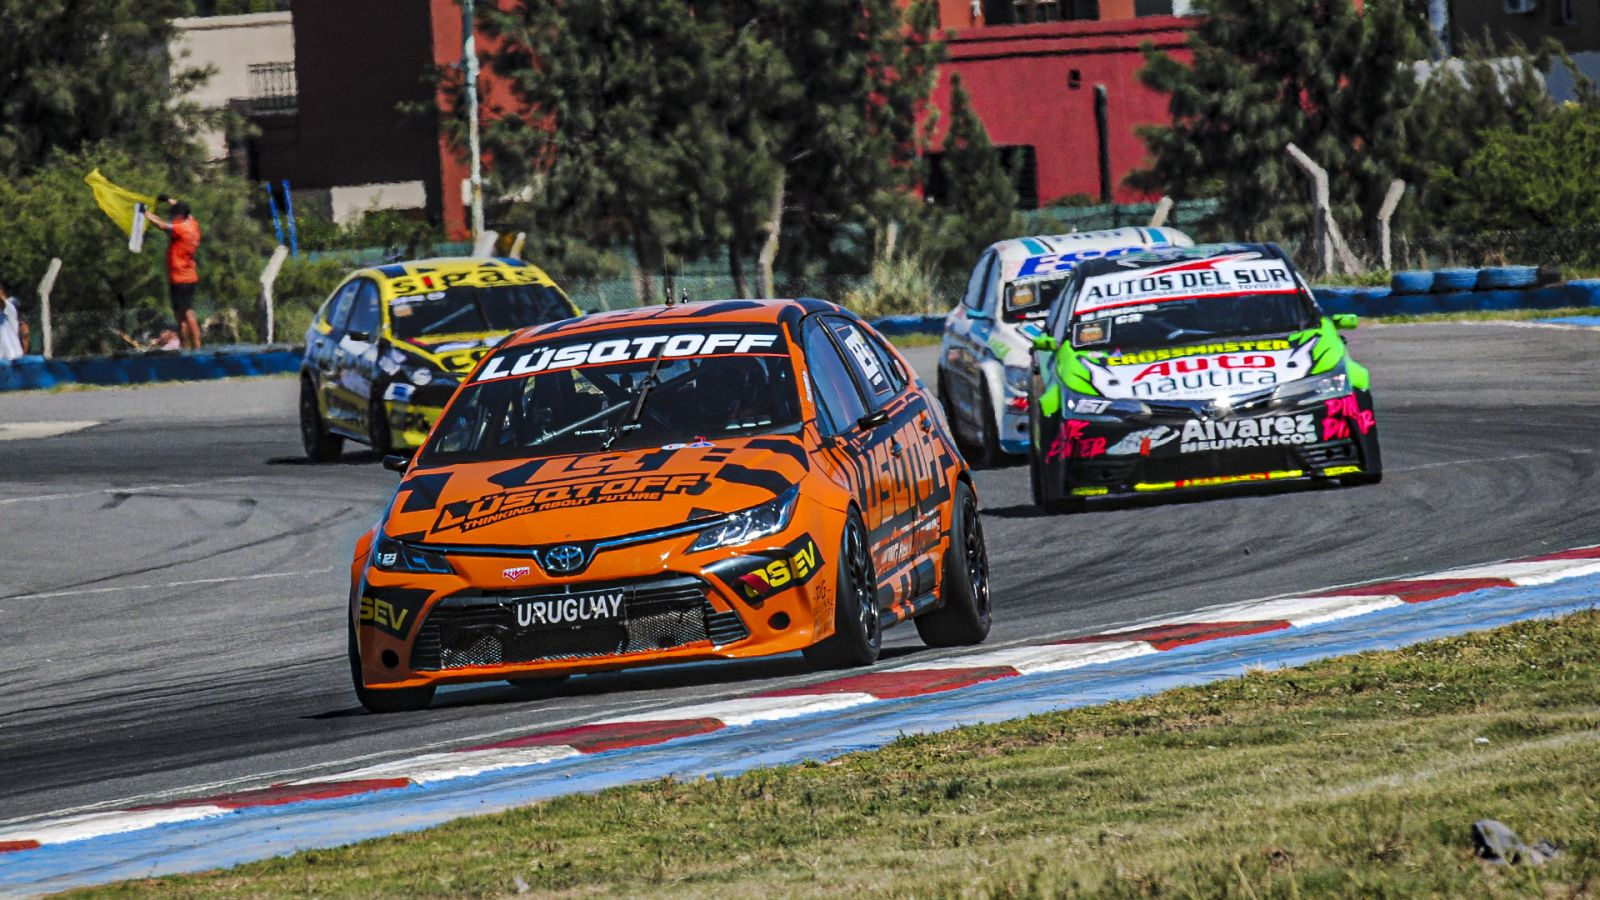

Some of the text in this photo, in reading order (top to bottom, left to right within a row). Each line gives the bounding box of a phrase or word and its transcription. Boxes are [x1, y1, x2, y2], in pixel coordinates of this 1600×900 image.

[1085, 274, 1172, 299] AUTOS
[1181, 269, 1230, 289] DEL
[1235, 268, 1290, 284] SUR
[476, 334, 778, 382] LÜSQTOFF
[1106, 340, 1291, 367] CROSSMASTER
[1181, 413, 1316, 443] Alvarez
[463, 491, 662, 531] THINKING ABOUT FUTURE
[516, 594, 624, 627] URUGUAY
